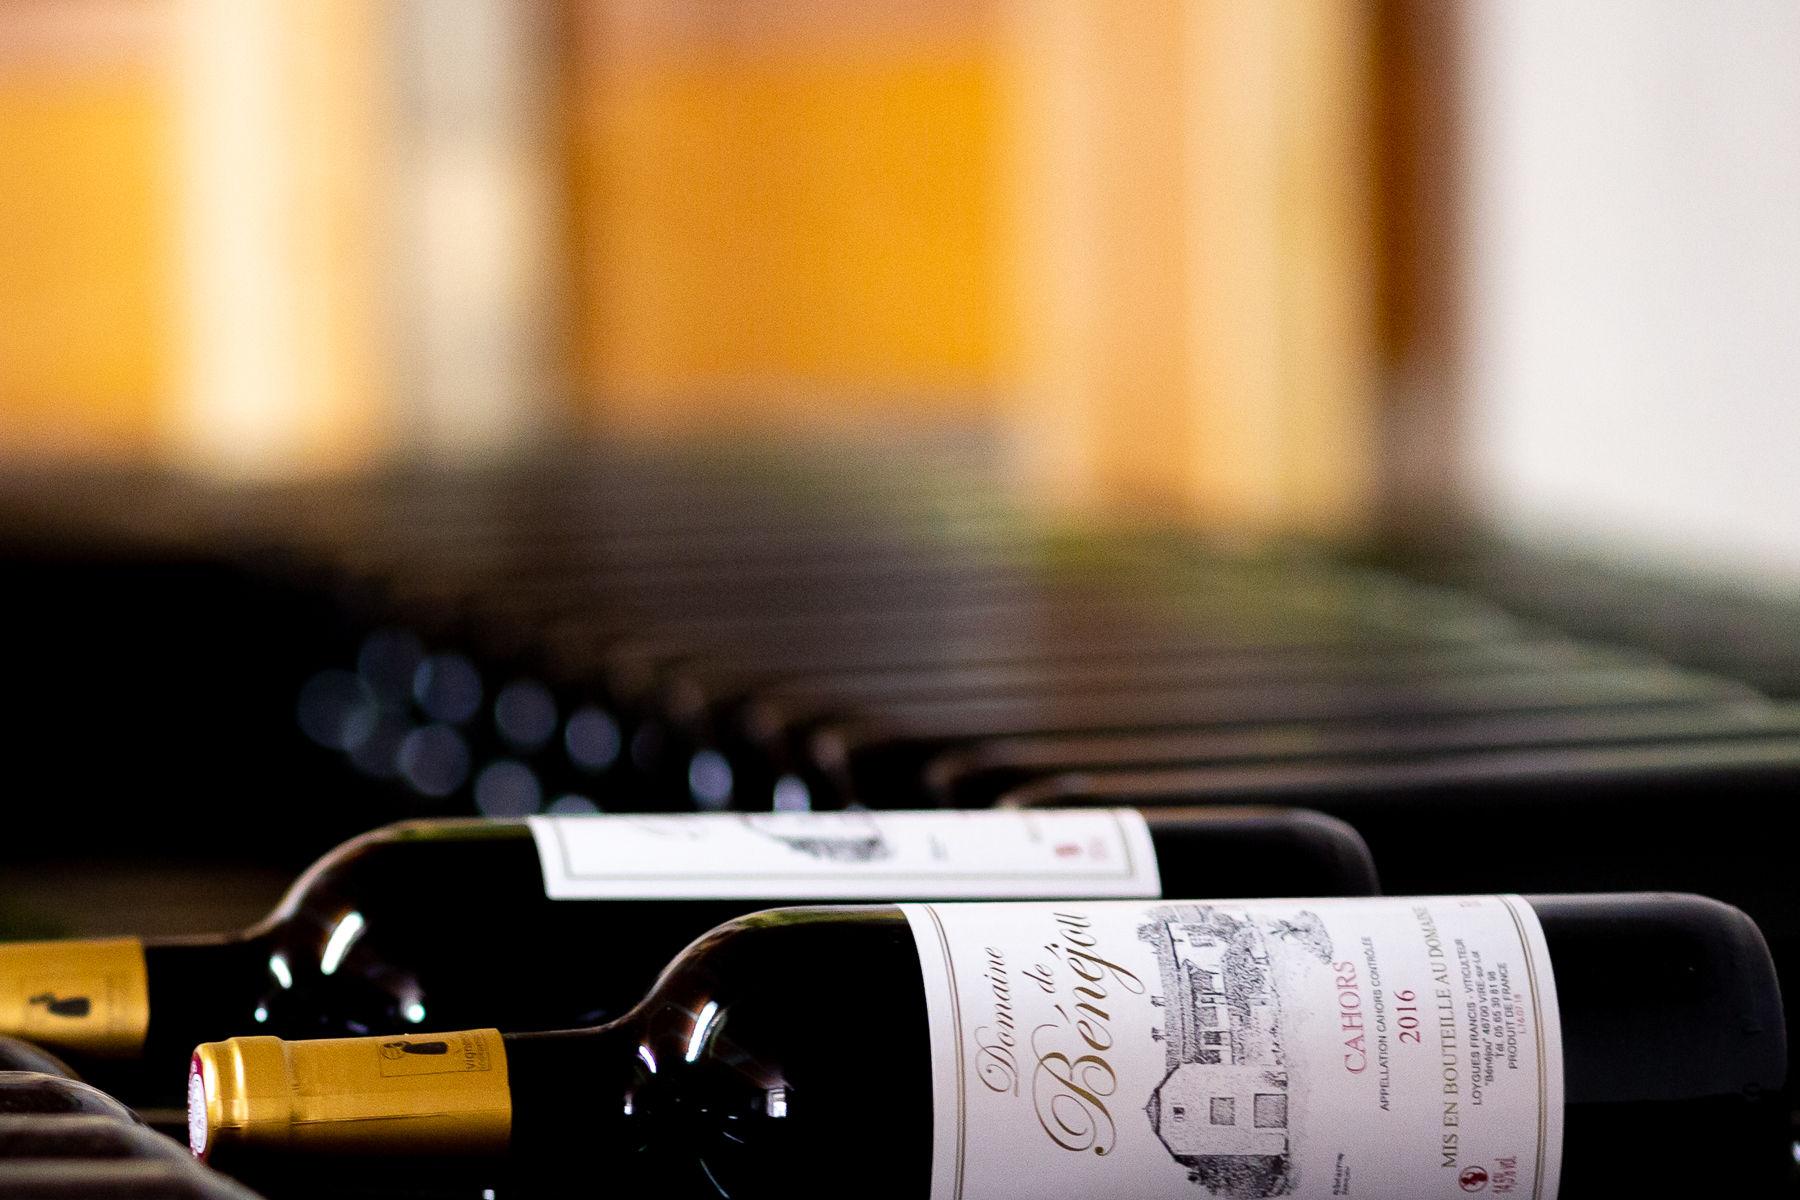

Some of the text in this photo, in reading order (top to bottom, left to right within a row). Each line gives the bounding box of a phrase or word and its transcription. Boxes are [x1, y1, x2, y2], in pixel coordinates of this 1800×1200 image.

[1022, 964, 1056, 994] de
[1430, 961, 1450, 986] AU
[975, 946, 1019, 1097] Domaine
[1031, 912, 1145, 1156] Bénéjou
[1333, 961, 1368, 1074] CAHORS
[1372, 989, 1388, 1033] CAHORS
[1393, 990, 1421, 1044] 2016
[1466, 1002, 1480, 1048] FRANCIS
[1504, 1003, 1515, 1018] DE
[1435, 988, 1459, 1095] BOUTEILLE
[1506, 1020, 1519, 1070] PRODUIT
[1378, 1034, 1391, 1112] APPELLATION
[1470, 1051, 1482, 1105] LOYGUES
[1442, 1101, 1459, 1128] EN
[1441, 1133, 1459, 1169] MIS
